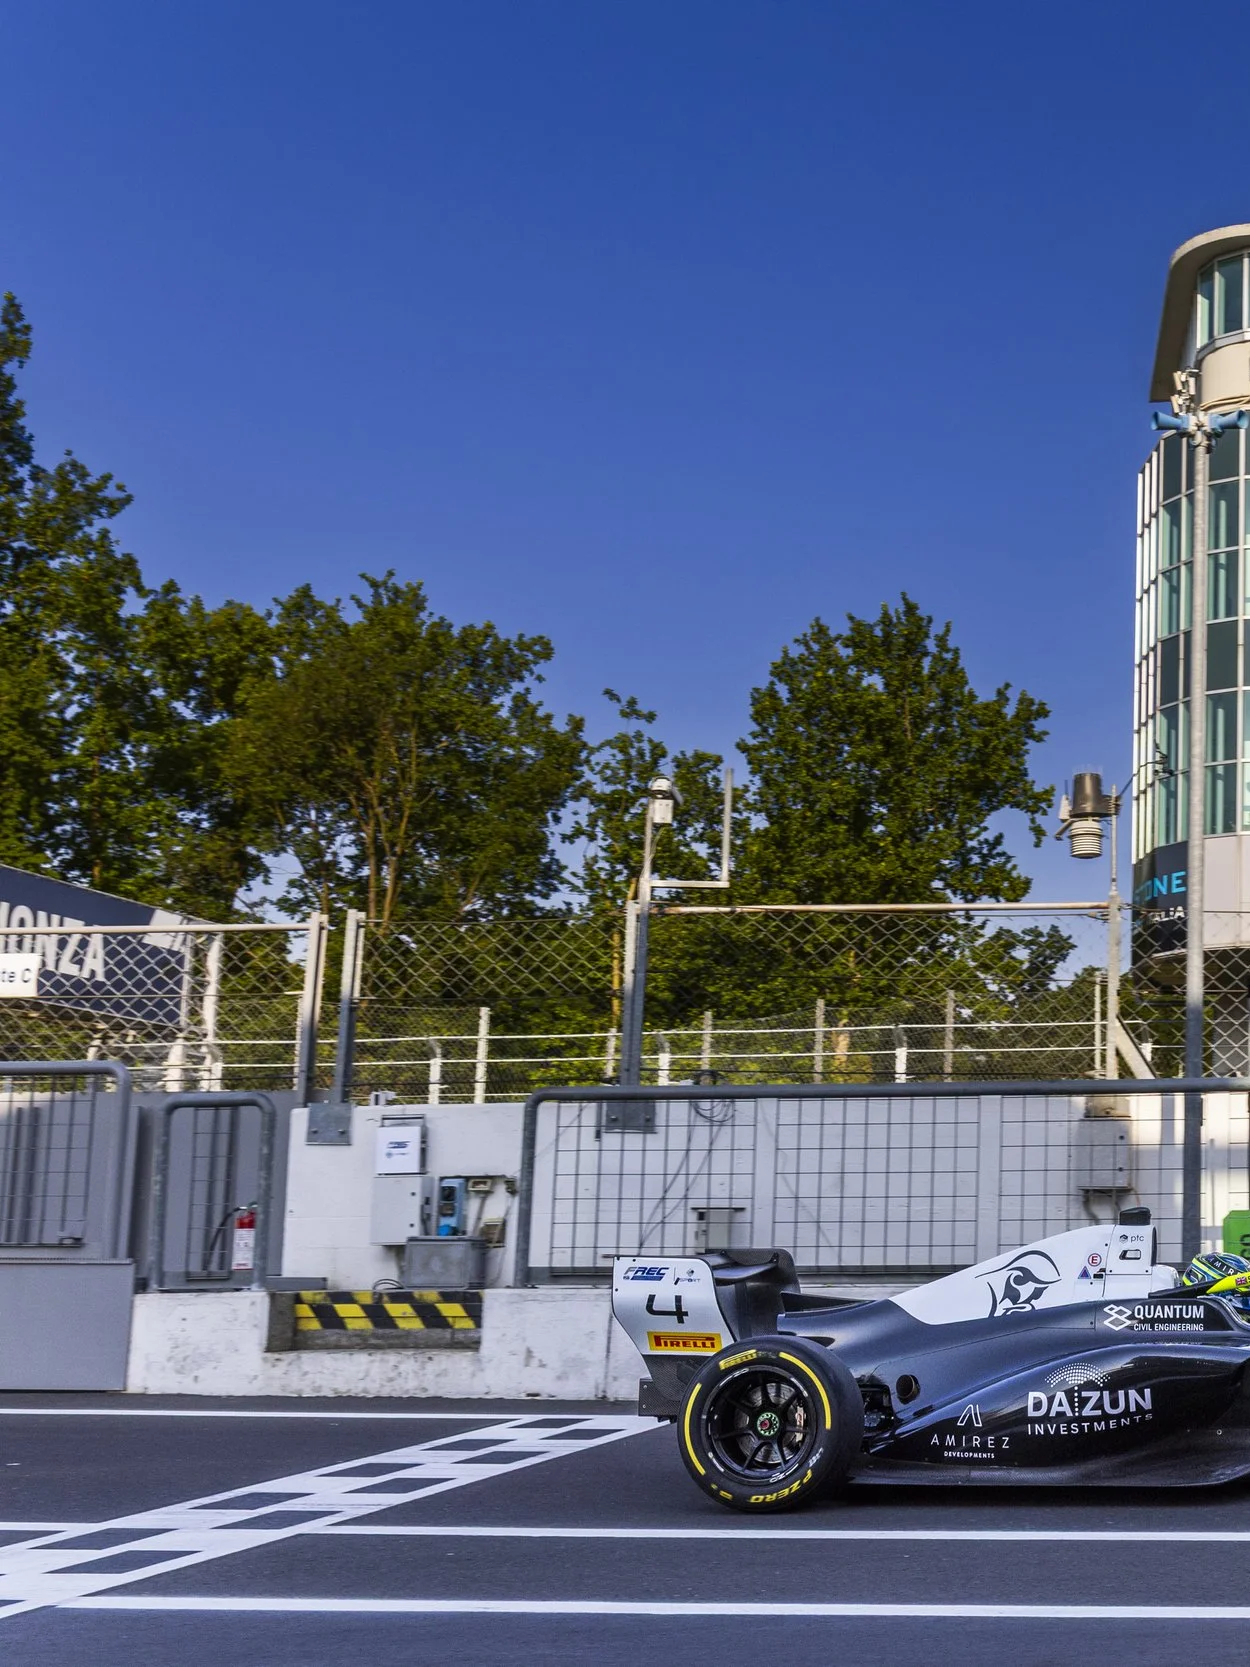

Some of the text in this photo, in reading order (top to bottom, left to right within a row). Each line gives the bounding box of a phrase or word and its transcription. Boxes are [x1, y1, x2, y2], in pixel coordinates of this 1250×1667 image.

[22, 968, 31, 983] C
[1130, 1235, 1144, 1243] ptc
[1091, 1256, 1099, 1264] E
[1208, 1257, 1240, 1276] AMIR
[624, 1266, 670, 1276] FREC
[646, 1294, 688, 1324] 4
[1134, 1305, 1204, 1320] QUANTUM
[1134, 1323, 1204, 1332] CIVIL ENGINEERING
[654, 1334, 716, 1349] PIRELLI
[1027, 1413, 1153, 1436] INVESTMENTS
[930, 1433, 1010, 1450] AMIREZ
[943, 1450, 995, 1460] DEVELOPMENTS
